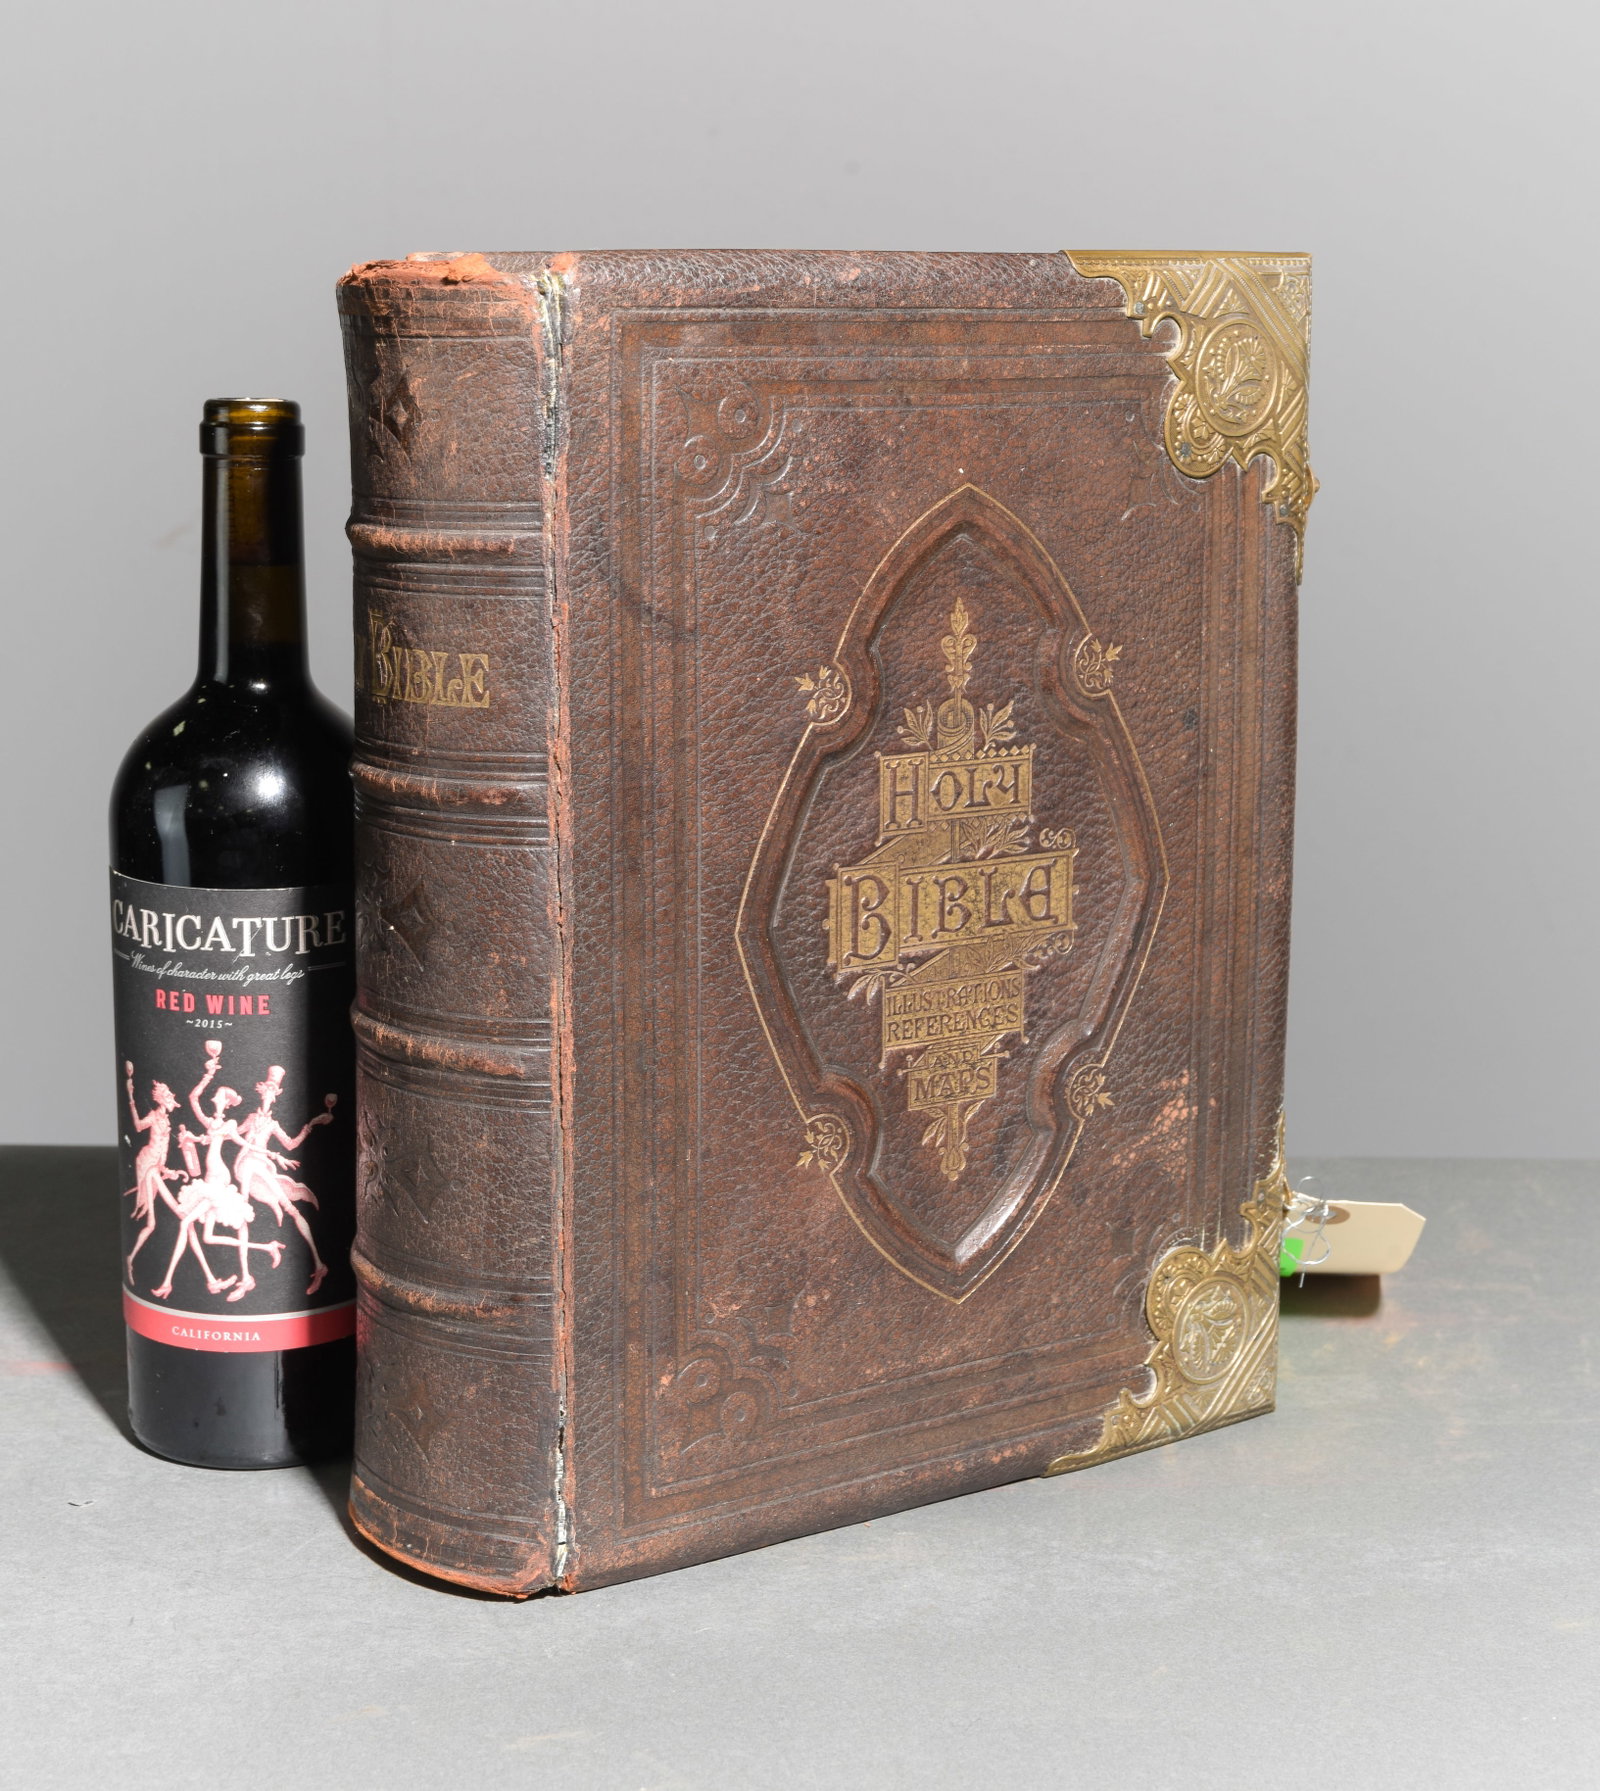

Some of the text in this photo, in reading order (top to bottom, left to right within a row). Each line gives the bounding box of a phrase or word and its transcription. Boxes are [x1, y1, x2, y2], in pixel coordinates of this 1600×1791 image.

[370, 608, 490, 708] BIBLE
[885, 759, 1022, 829] HOLY
[112, 899, 347, 957] CARICATURE
[843, 858, 1060, 966] BIBLE
[131, 951, 305, 988] Wines of character with great legs
[155, 988, 271, 1015] RED WINE
[887, 977, 1021, 1017] ILLUSTRATIONS
[887, 1002, 1019, 1042] REFERENCES
[930, 1050, 975, 1069] AND
[911, 1062, 992, 1101] MAPS
[171, 1326, 261, 1341] CALIFORNIA
